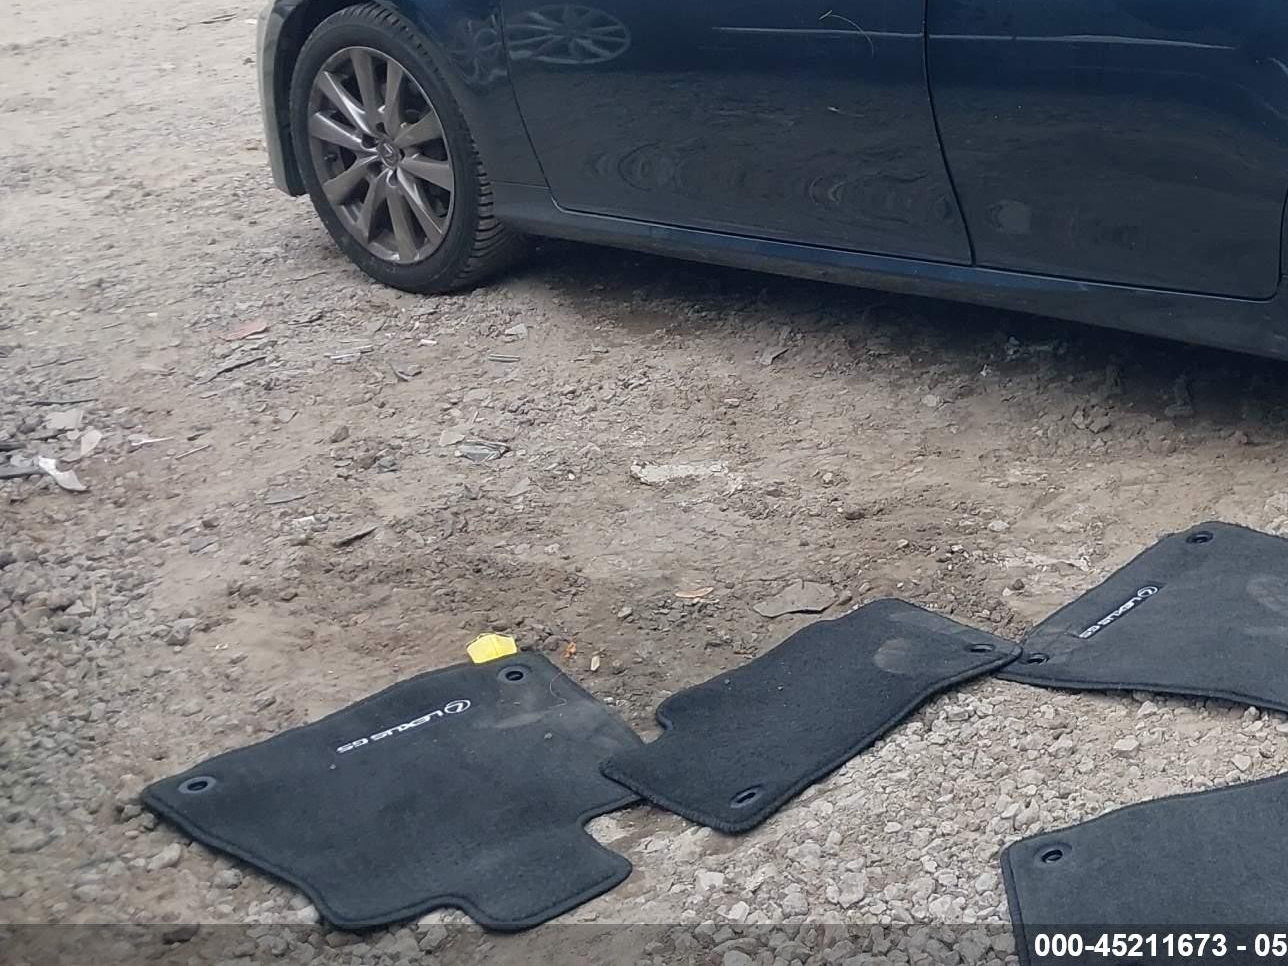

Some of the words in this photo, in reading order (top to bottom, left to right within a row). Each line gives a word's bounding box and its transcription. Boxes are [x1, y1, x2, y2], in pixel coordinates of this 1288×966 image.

[1097, 597, 1142, 626] LEXUS
[370, 710, 444, 741] LEXUS
[336, 738, 369, 754] GS
